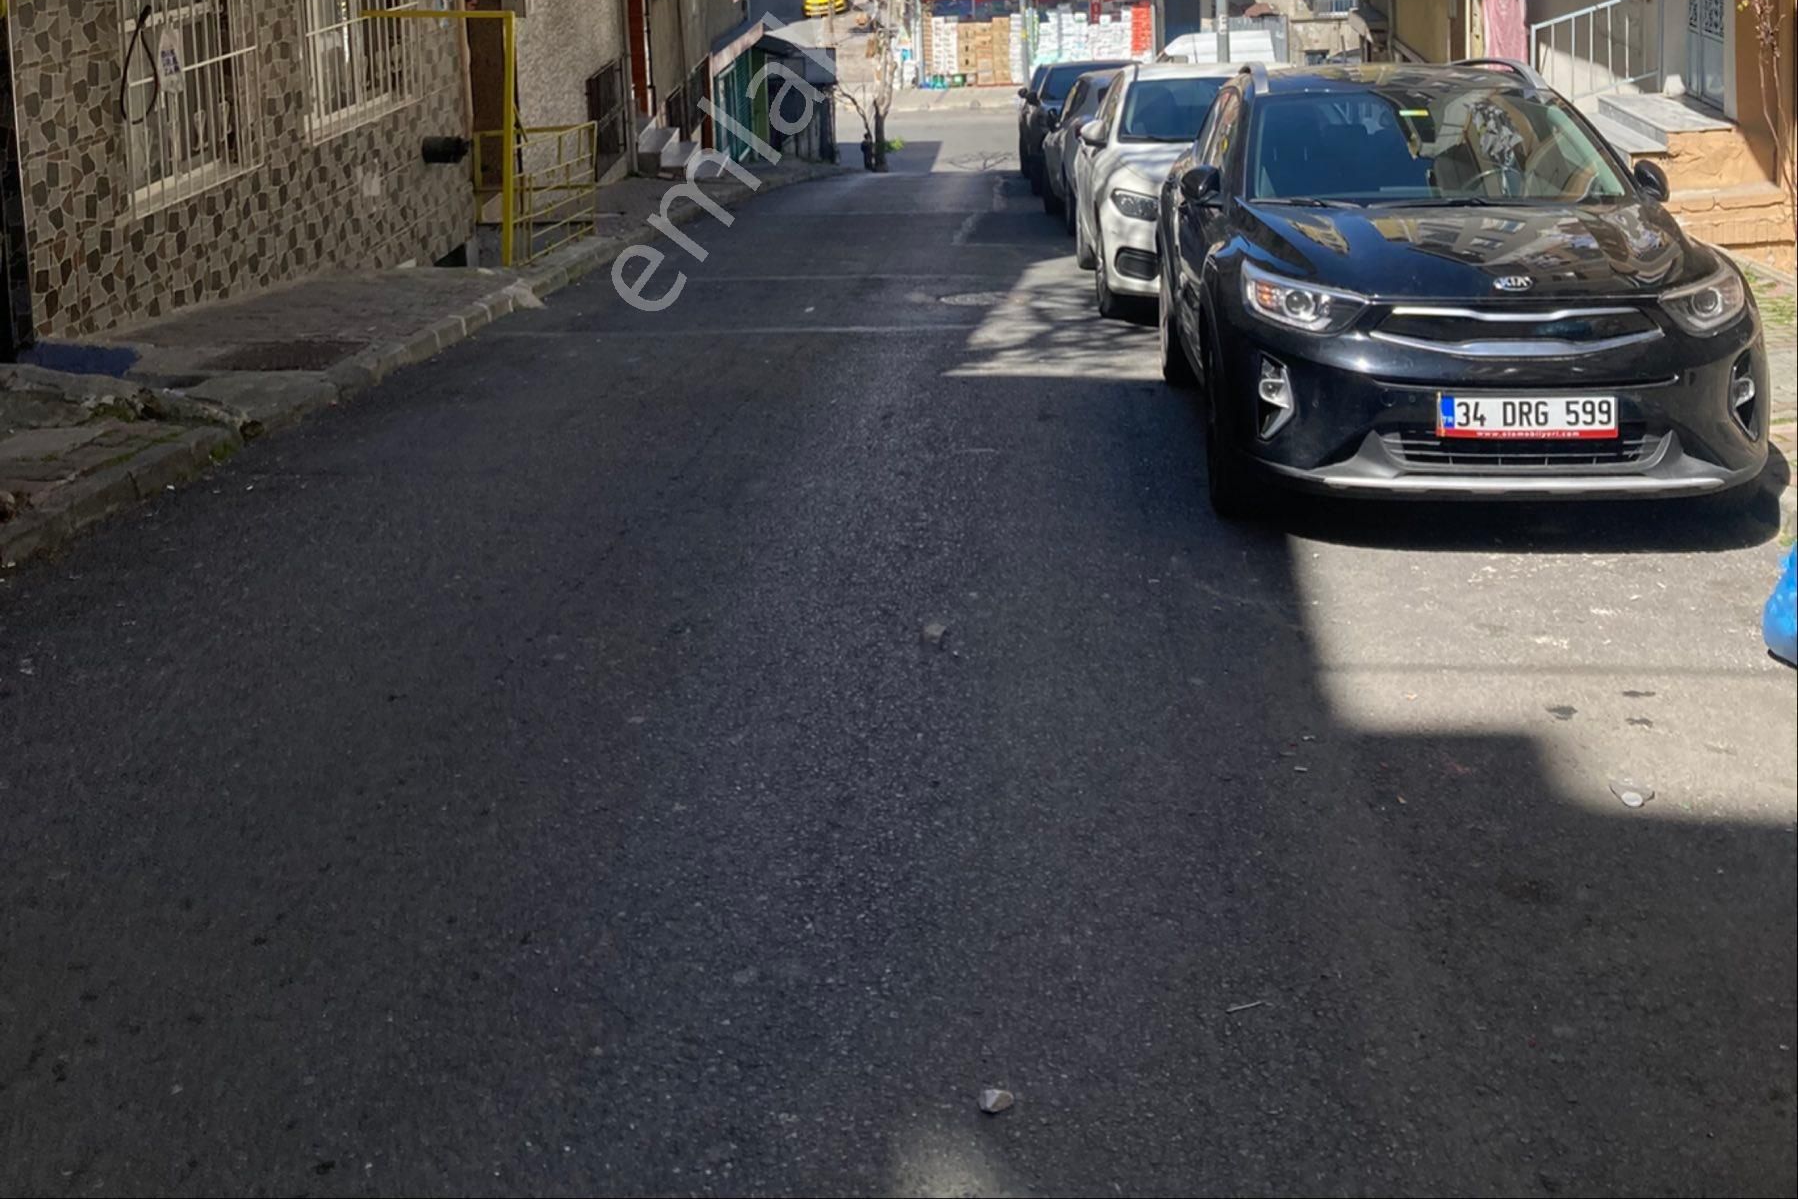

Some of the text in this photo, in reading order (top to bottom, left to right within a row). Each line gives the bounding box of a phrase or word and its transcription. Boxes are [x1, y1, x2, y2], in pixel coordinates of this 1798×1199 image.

[1456, 400, 1612, 427] 34 DRG 599
